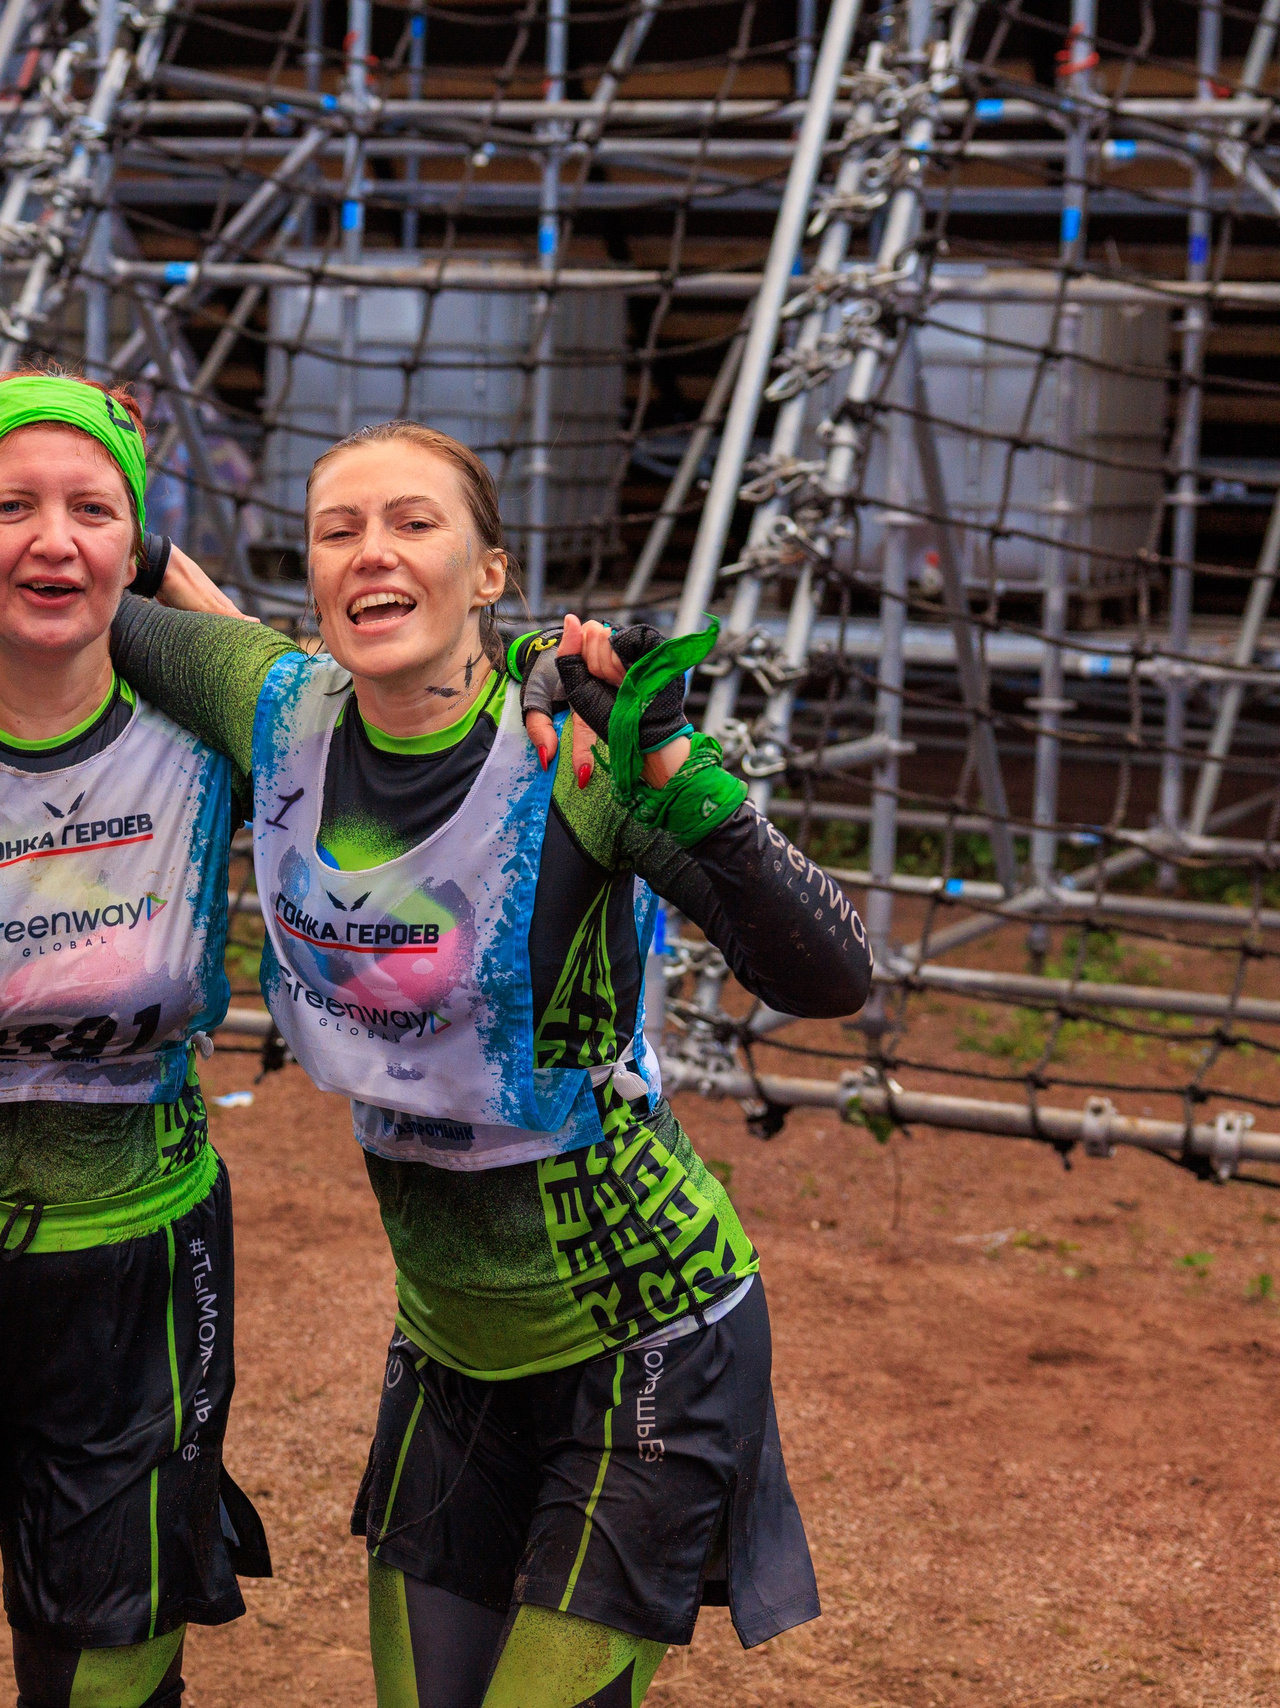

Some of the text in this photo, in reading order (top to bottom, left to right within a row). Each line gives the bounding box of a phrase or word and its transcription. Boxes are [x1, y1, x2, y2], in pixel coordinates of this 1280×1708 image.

[61, 813, 154, 845] ГЕРОЕВ
[275, 892, 439, 944] ГОНКА ГЕРОЕВ
[22, 936, 107, 957] GLOBAL
[319, 1017, 400, 1043] GLOBAL
